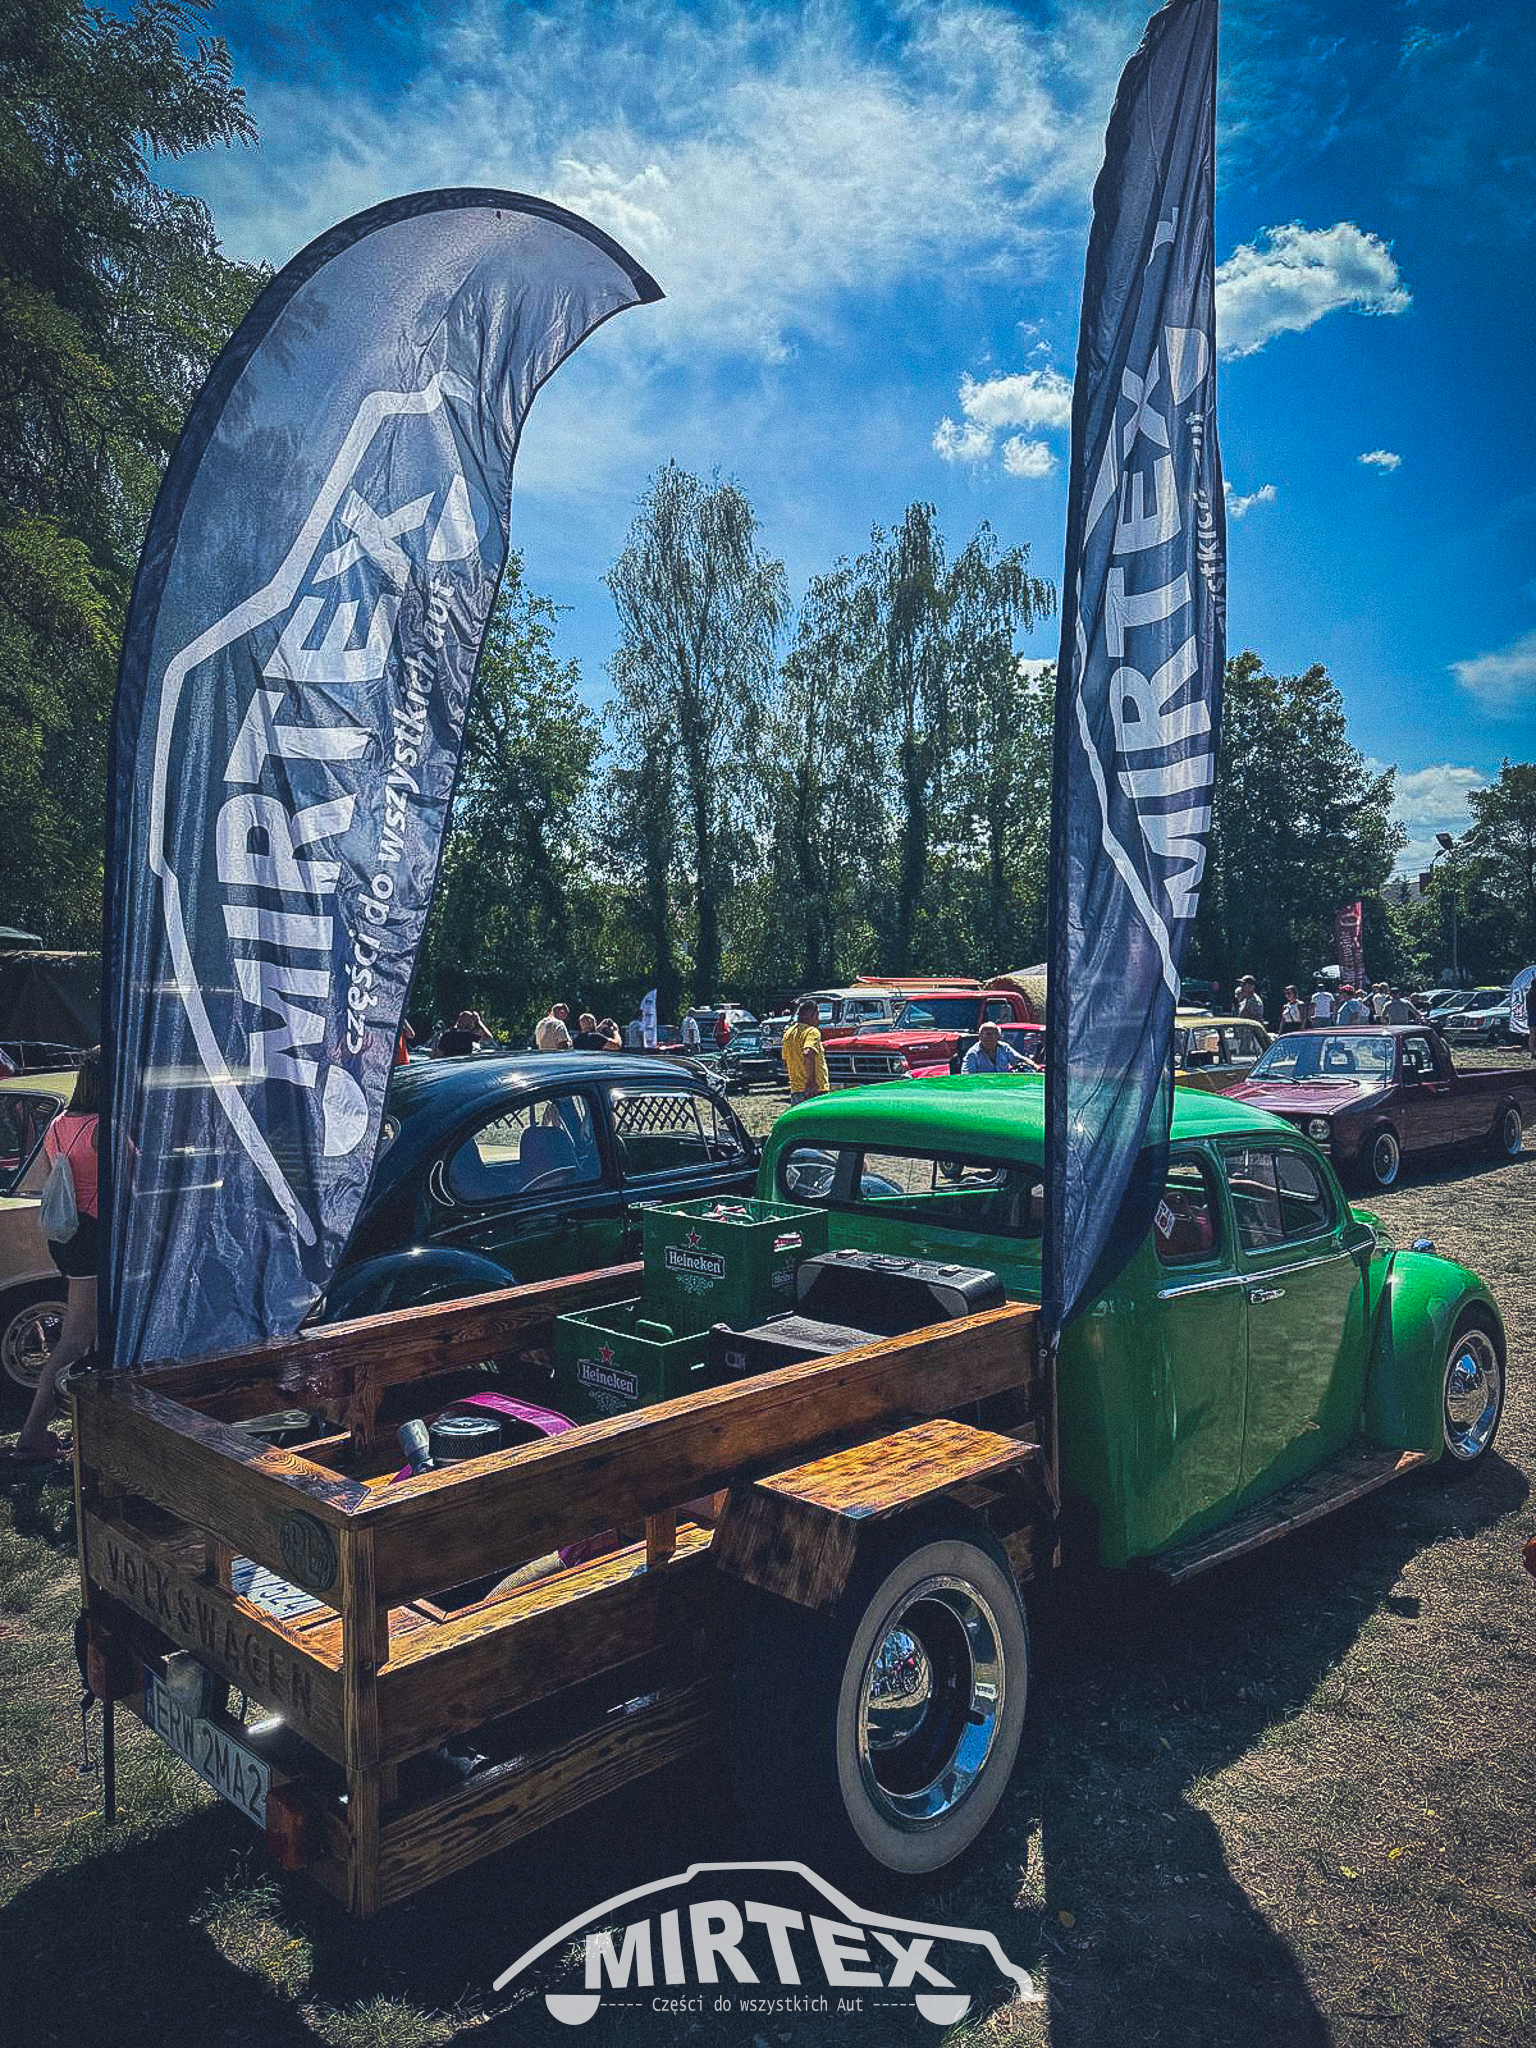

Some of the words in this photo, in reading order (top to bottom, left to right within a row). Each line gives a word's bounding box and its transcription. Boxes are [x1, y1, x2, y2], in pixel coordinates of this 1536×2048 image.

[423, 579, 455, 649] aut
[1105, 345, 1215, 918] MIRTEX
[215, 489, 435, 1089] MIRTEX
[379, 651, 436, 863] wszystkich
[358, 873, 394, 925] do
[346, 928, 381, 1054] części
[668, 1250, 721, 1273] Heineken
[582, 1367, 634, 1393] Heineken
[106, 1540, 312, 1718] VOLKSWAGEN
